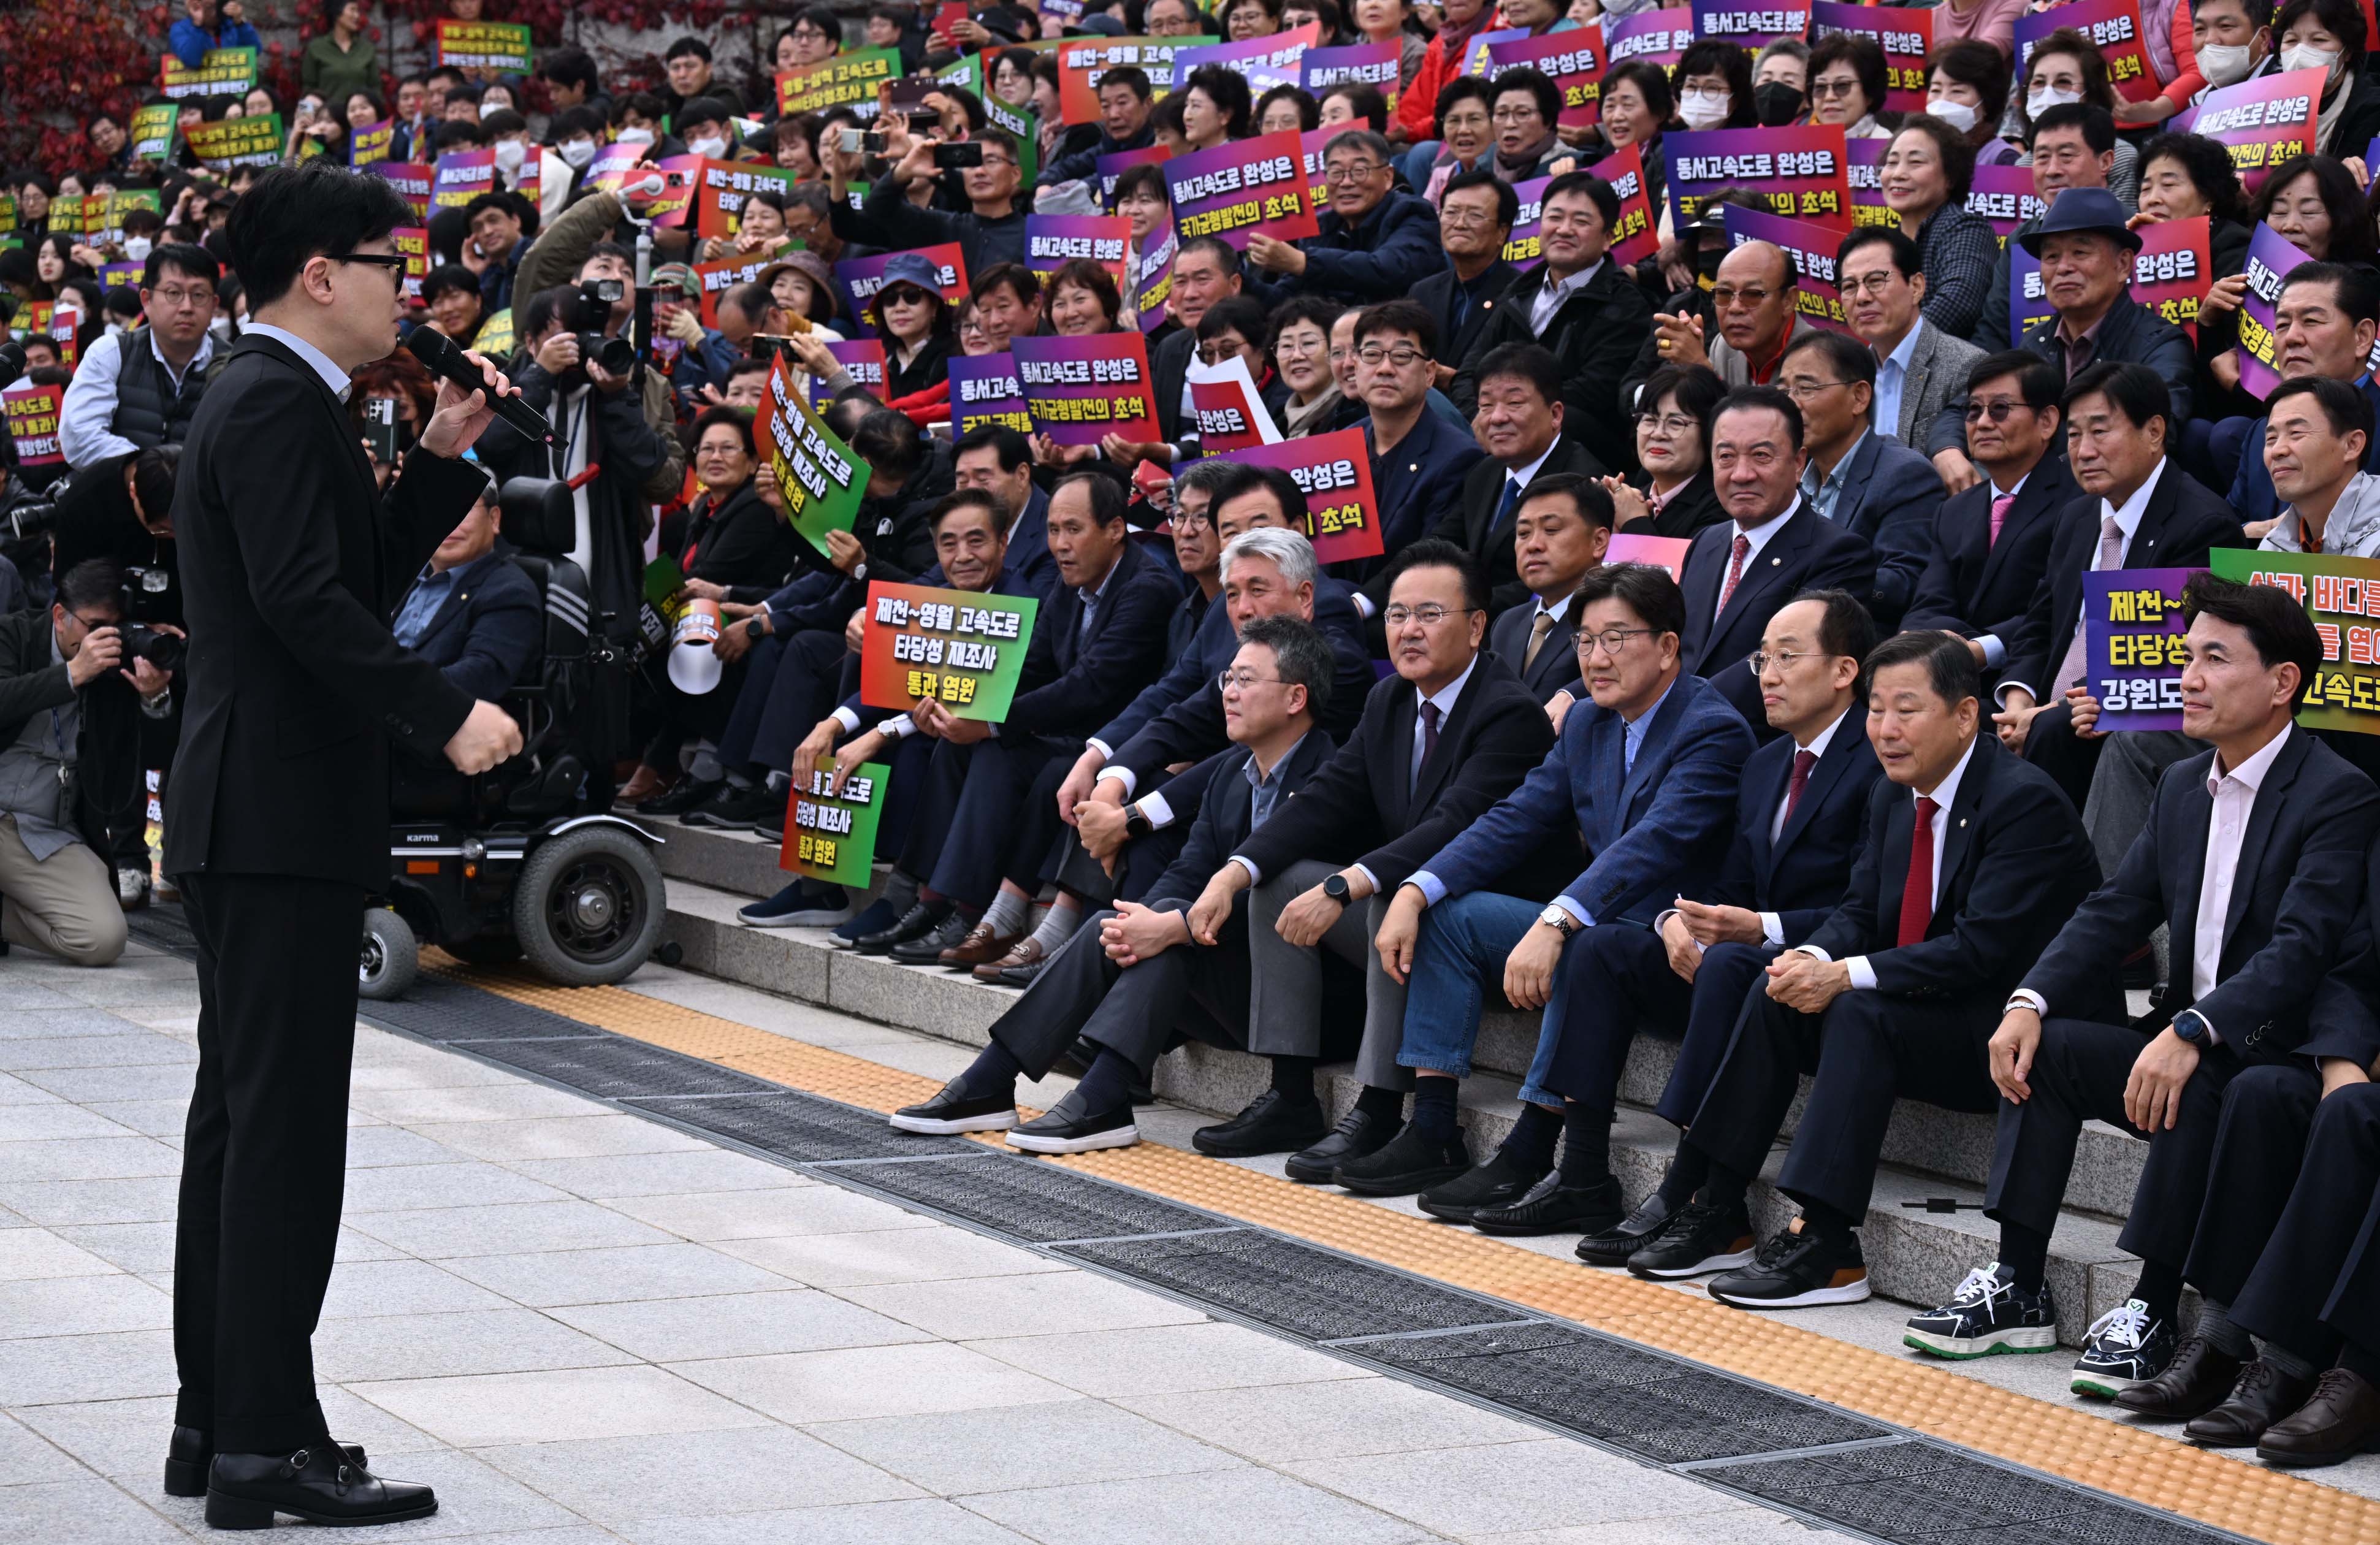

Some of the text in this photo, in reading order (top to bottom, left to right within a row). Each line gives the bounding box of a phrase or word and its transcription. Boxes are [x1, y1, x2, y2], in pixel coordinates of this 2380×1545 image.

[1703, 11, 1785, 34] 동서고속도로
[2093, 16, 2134, 45] 완성은
[1142, 45, 1197, 63] 고속
[1883, 31, 1924, 55] 완성은
[836, 58, 888, 80] 고속도로
[1539, 49, 1594, 76] 완성은
[2116, 54, 2143, 80] 초석
[1566, 82, 1600, 106] 초석
[2265, 96, 2309, 123] 완성은
[1677, 151, 1834, 181] 동서고속도로 완성은
[1173, 163, 1240, 204] 동서고속도로
[1244, 156, 1292, 185] 완성은
[719, 192, 744, 212] 타당
[1265, 193, 1300, 219] 초석
[1801, 192, 1837, 215] 초석
[1180, 200, 1260, 237] 국가균형발전의
[1627, 208, 1647, 235] 초석
[1031, 237, 1123, 259] 동서고속도로 완성은
[1807, 252, 1835, 281] 완성
[2136, 250, 2195, 282] 완성은
[1829, 299, 1845, 322] 초
[2161, 297, 2199, 324] 초석
[1021, 359, 1138, 383] 동서고속도로 완성은
[960, 375, 1023, 402] 동서고속
[1029, 395, 1144, 421] 국가균형발전의 초석
[1200, 408, 1245, 433] 완성은
[770, 410, 826, 498] 타당성 재조사
[802, 425, 852, 487] 고속도로
[1291, 460, 1355, 492] 완성은
[785, 475, 804, 513] 염원
[1320, 503, 1363, 533] 초석
[875, 597, 1020, 638] 제천~영월 고속도로
[2108, 590, 2192, 622] 제천~
[894, 635, 996, 670] 타당성 재조사
[907, 671, 975, 703] 통과 염원
[796, 801, 851, 834] 타당성 재조사
[799, 836, 836, 865] 통과 염원
